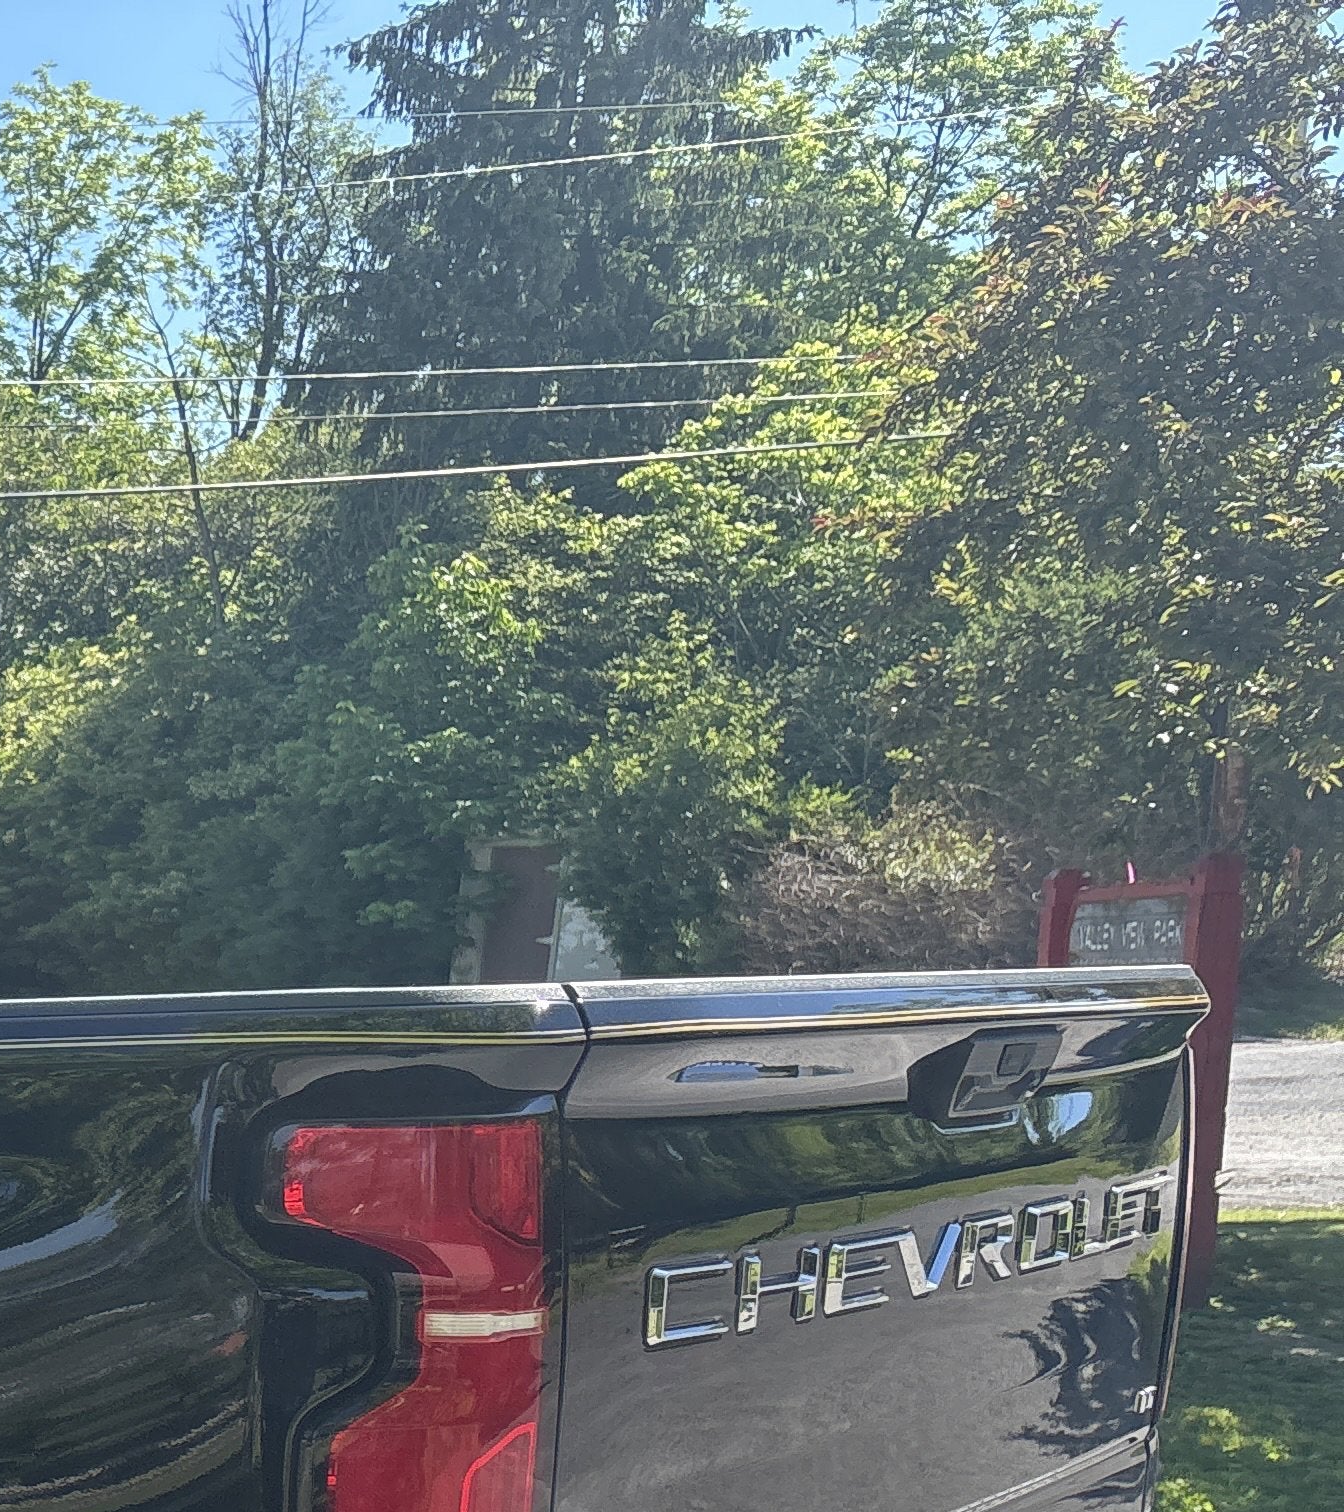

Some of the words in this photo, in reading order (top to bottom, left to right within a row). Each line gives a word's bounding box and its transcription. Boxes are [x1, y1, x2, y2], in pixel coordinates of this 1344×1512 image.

[1079, 922, 1114, 950] VALLEY
[1122, 920, 1146, 950] VIEW
[1153, 919, 1182, 946] PARK
[645, 1171, 1174, 1349] CHEVROLET
